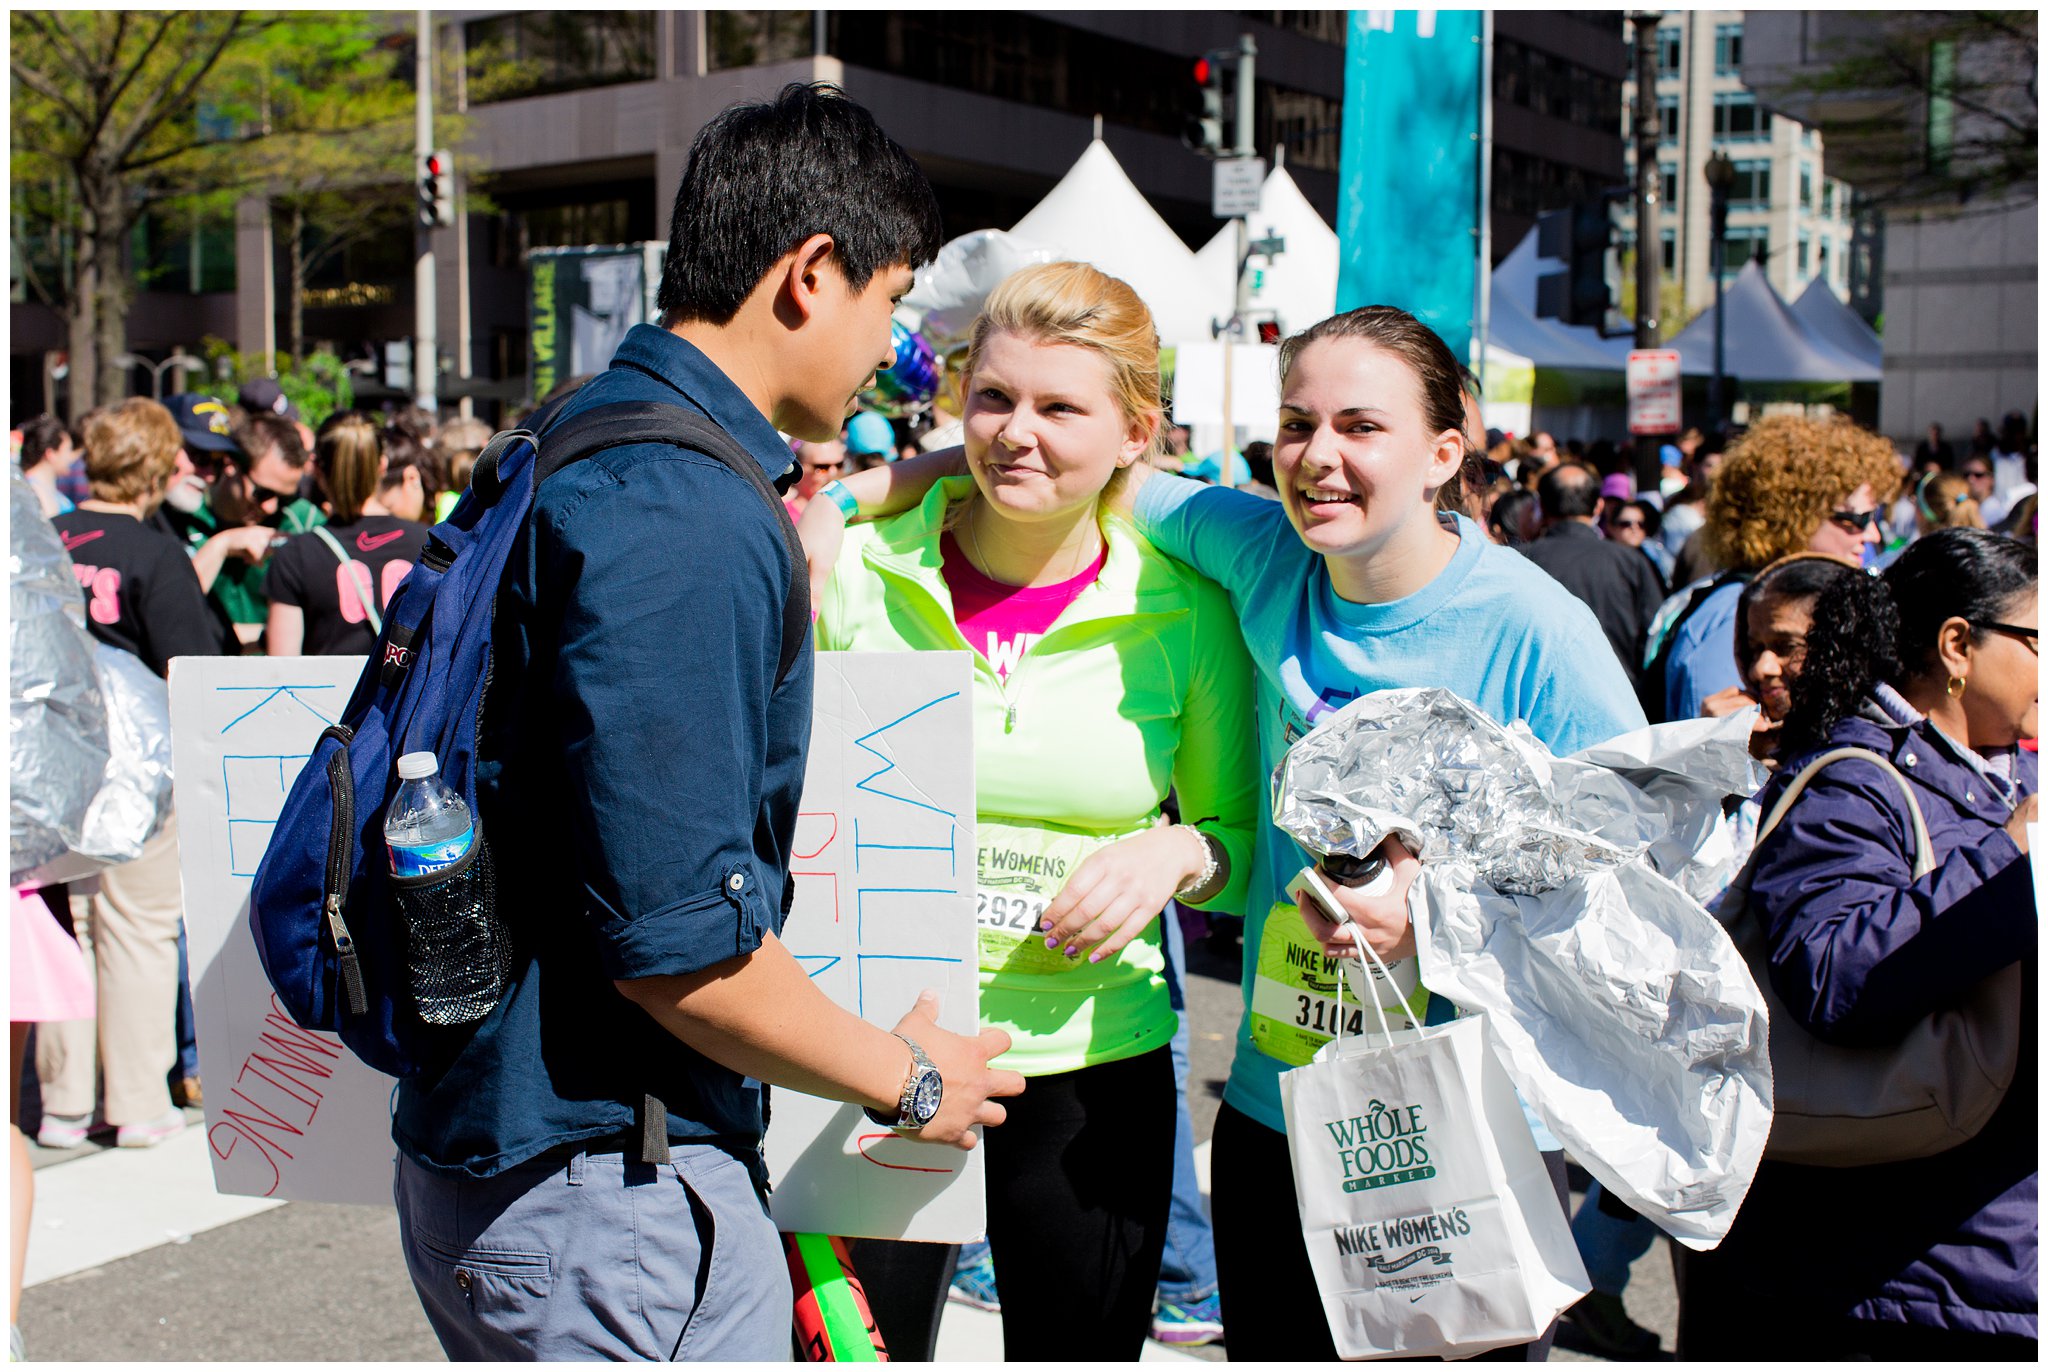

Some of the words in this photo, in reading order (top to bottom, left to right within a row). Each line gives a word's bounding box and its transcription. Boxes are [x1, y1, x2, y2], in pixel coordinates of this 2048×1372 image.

[854, 691, 962, 1019] WILL
[992, 847, 1066, 878] WOMEN'S
[1286, 942, 1320, 972] NIKE
[1295, 994, 1364, 1036] 3104
[208, 992, 343, 1196] UNNING
[1325, 1099, 1427, 1148] WHOLE
[1338, 1136, 1429, 1178] FOODS
[1349, 1168, 1429, 1190] MARKET
[1334, 1226, 1381, 1256] NIKE
[1382, 1206, 1471, 1249] WOMEN'S
